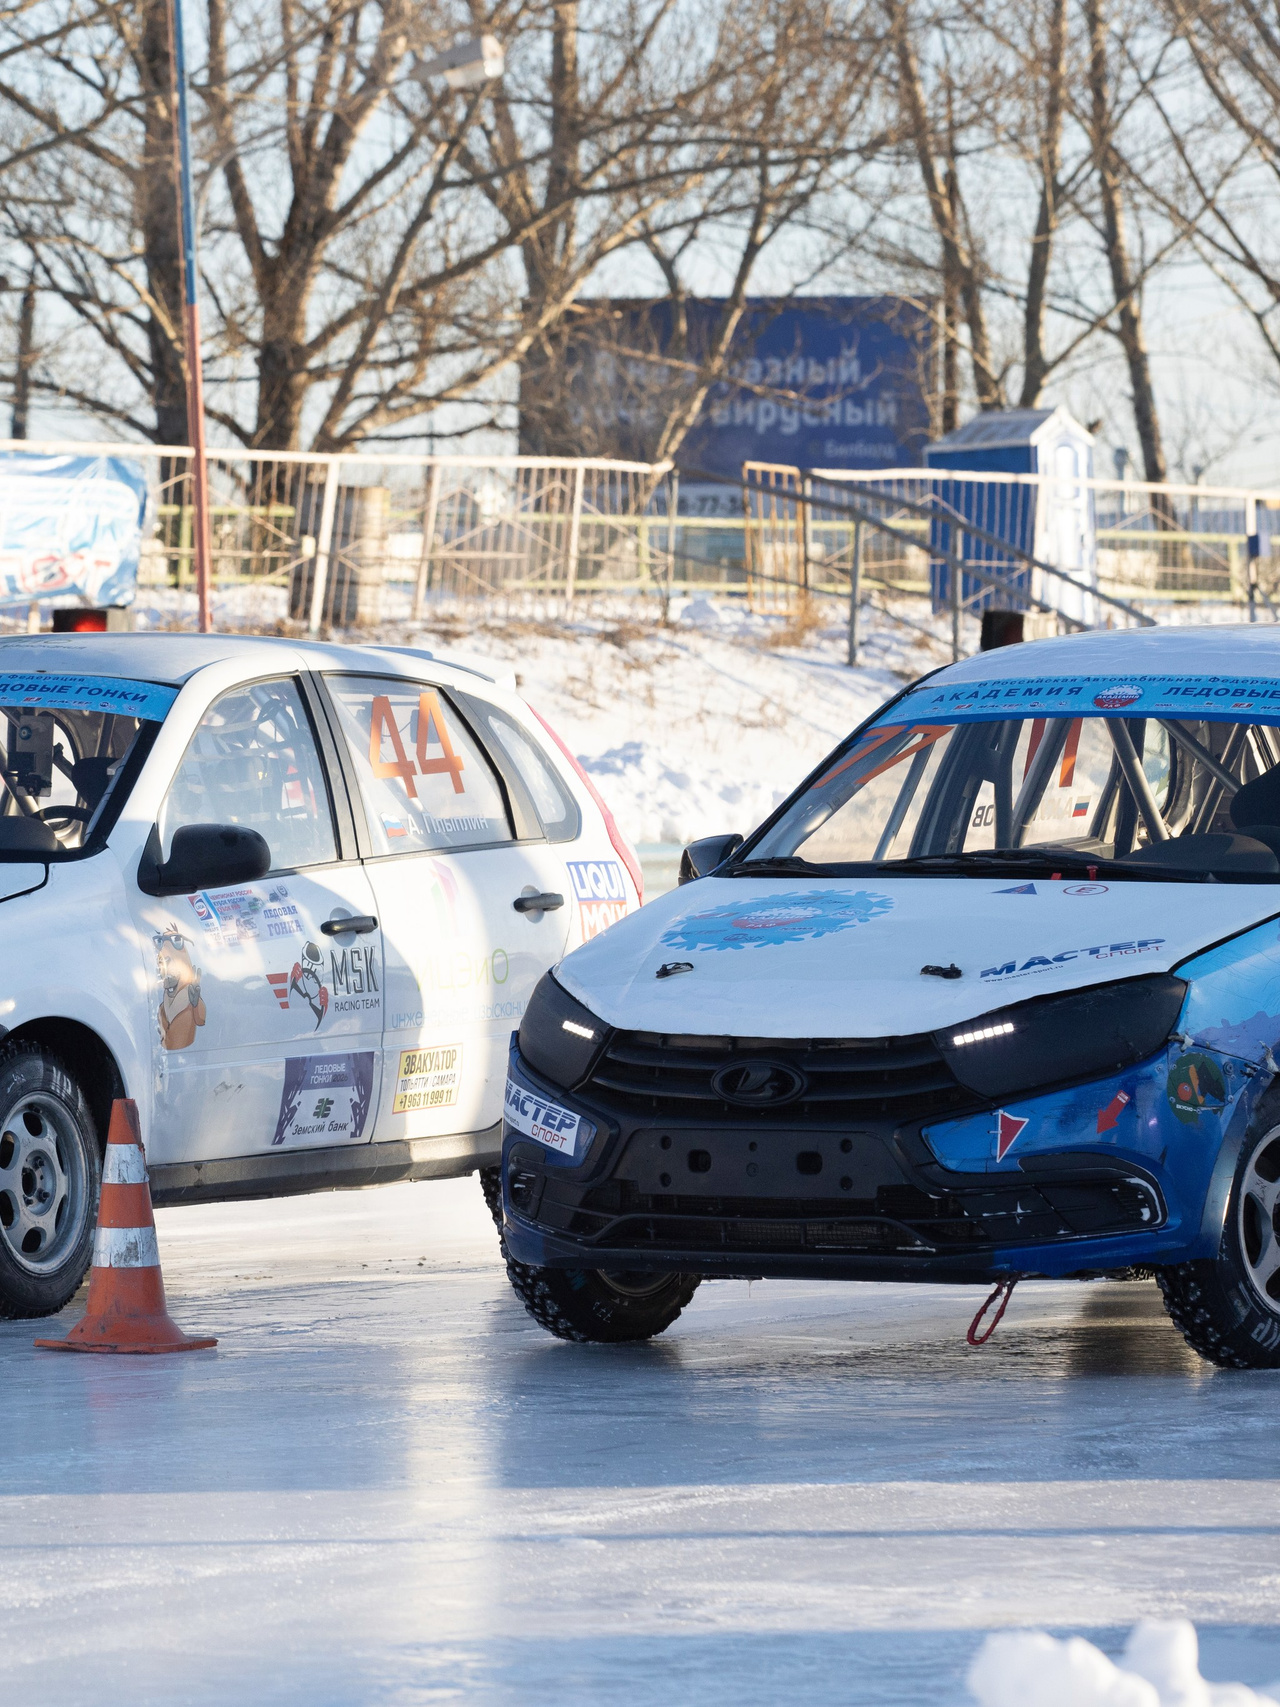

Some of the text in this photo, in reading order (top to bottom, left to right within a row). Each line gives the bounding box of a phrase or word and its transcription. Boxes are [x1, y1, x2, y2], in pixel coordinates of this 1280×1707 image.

[992, 676, 1280, 687] Российская Автомобильная Федерац
[74, 686, 149, 703] ГОНКИ
[931, 686, 1084, 704] АКАДЕМИЯ
[369, 692, 466, 799] 44
[569, 862, 625, 900] LIQUI
[263, 905, 298, 920] ЛЕДОВАЯ
[267, 919, 303, 938] ГОНКА
[979, 938, 1166, 979] МАСТЕР
[1095, 945, 1164, 960] СПОРТ
[330, 945, 380, 996] MSK
[983, 964, 1064, 984] www.master-sport.ru
[334, 997, 381, 1013] RACING TEAM
[314, 1062, 347, 1075] ЛЕДОВЫЕ
[403, 1049, 457, 1075] ЭВАКУАТОР
[310, 1074, 332, 1084] ГОНКИ
[407, 1093, 422, 1108] 963
[428, 1091, 444, 1105] 999
[445, 1090, 453, 1103] 11
[291, 1120, 349, 1136] Земский банк
[531, 1123, 568, 1149] СПОРТ
